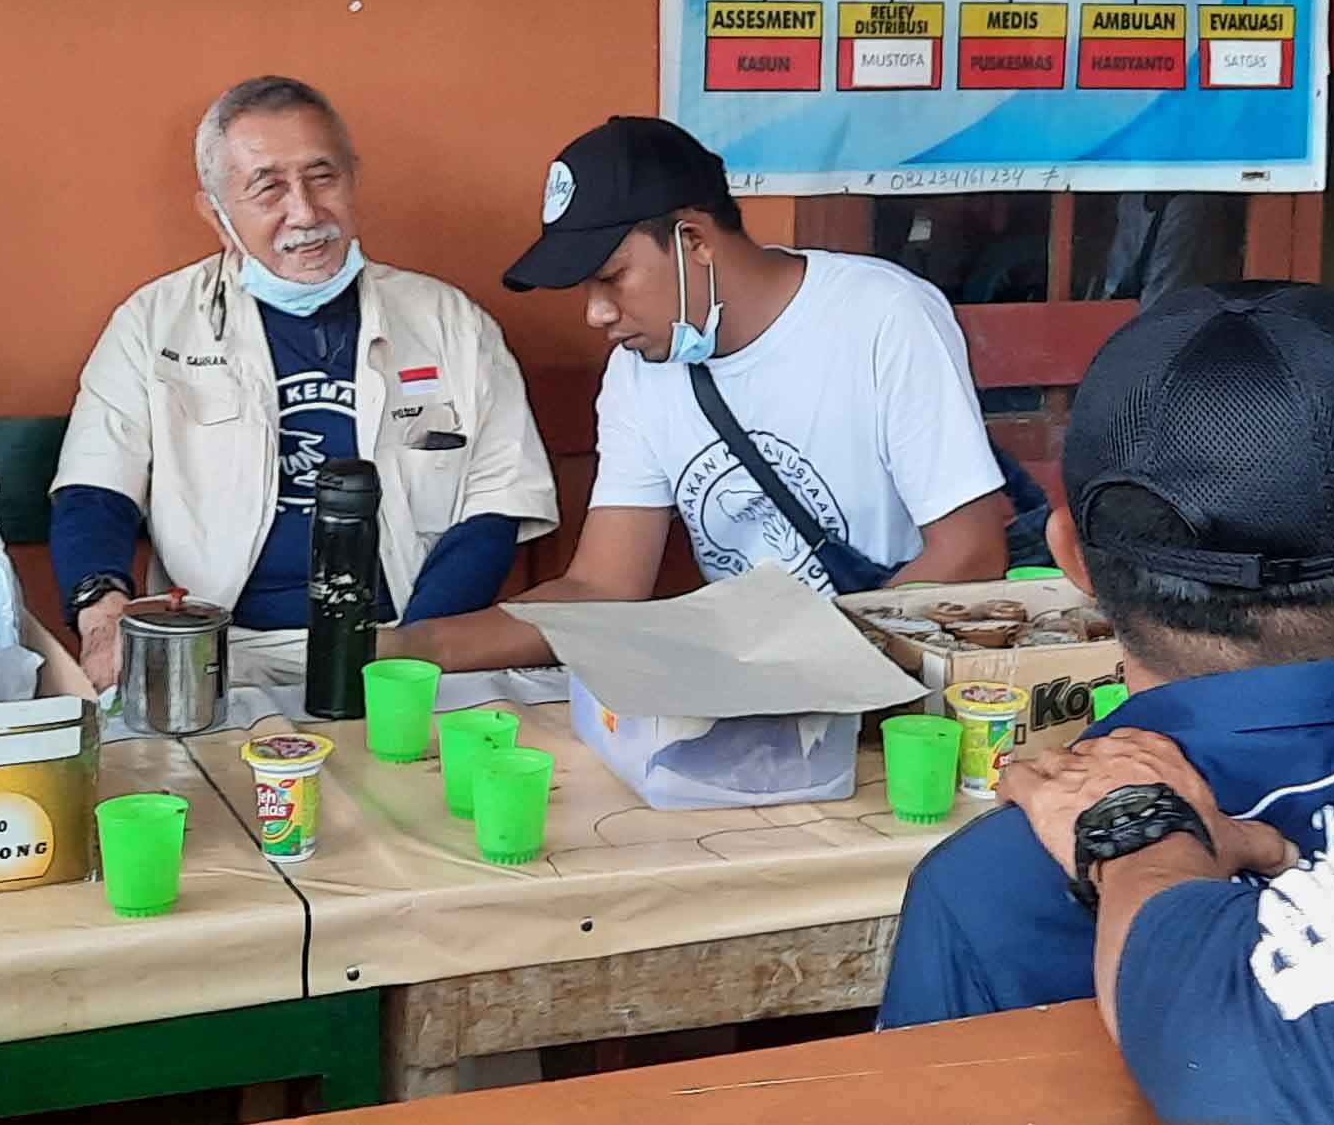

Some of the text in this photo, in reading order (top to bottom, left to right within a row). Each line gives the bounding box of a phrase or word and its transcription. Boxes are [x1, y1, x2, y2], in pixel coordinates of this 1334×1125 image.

[712, 10, 816, 30] ASSESMENT
[855, 20, 928, 35] DISTRIBUSI
[987, 11, 1038, 30] MEDIS
[1093, 12, 1176, 31] AMBULAN
[1210, 13, 1284, 32] EVAKUASI
[737, 55, 791, 73] KASUN
